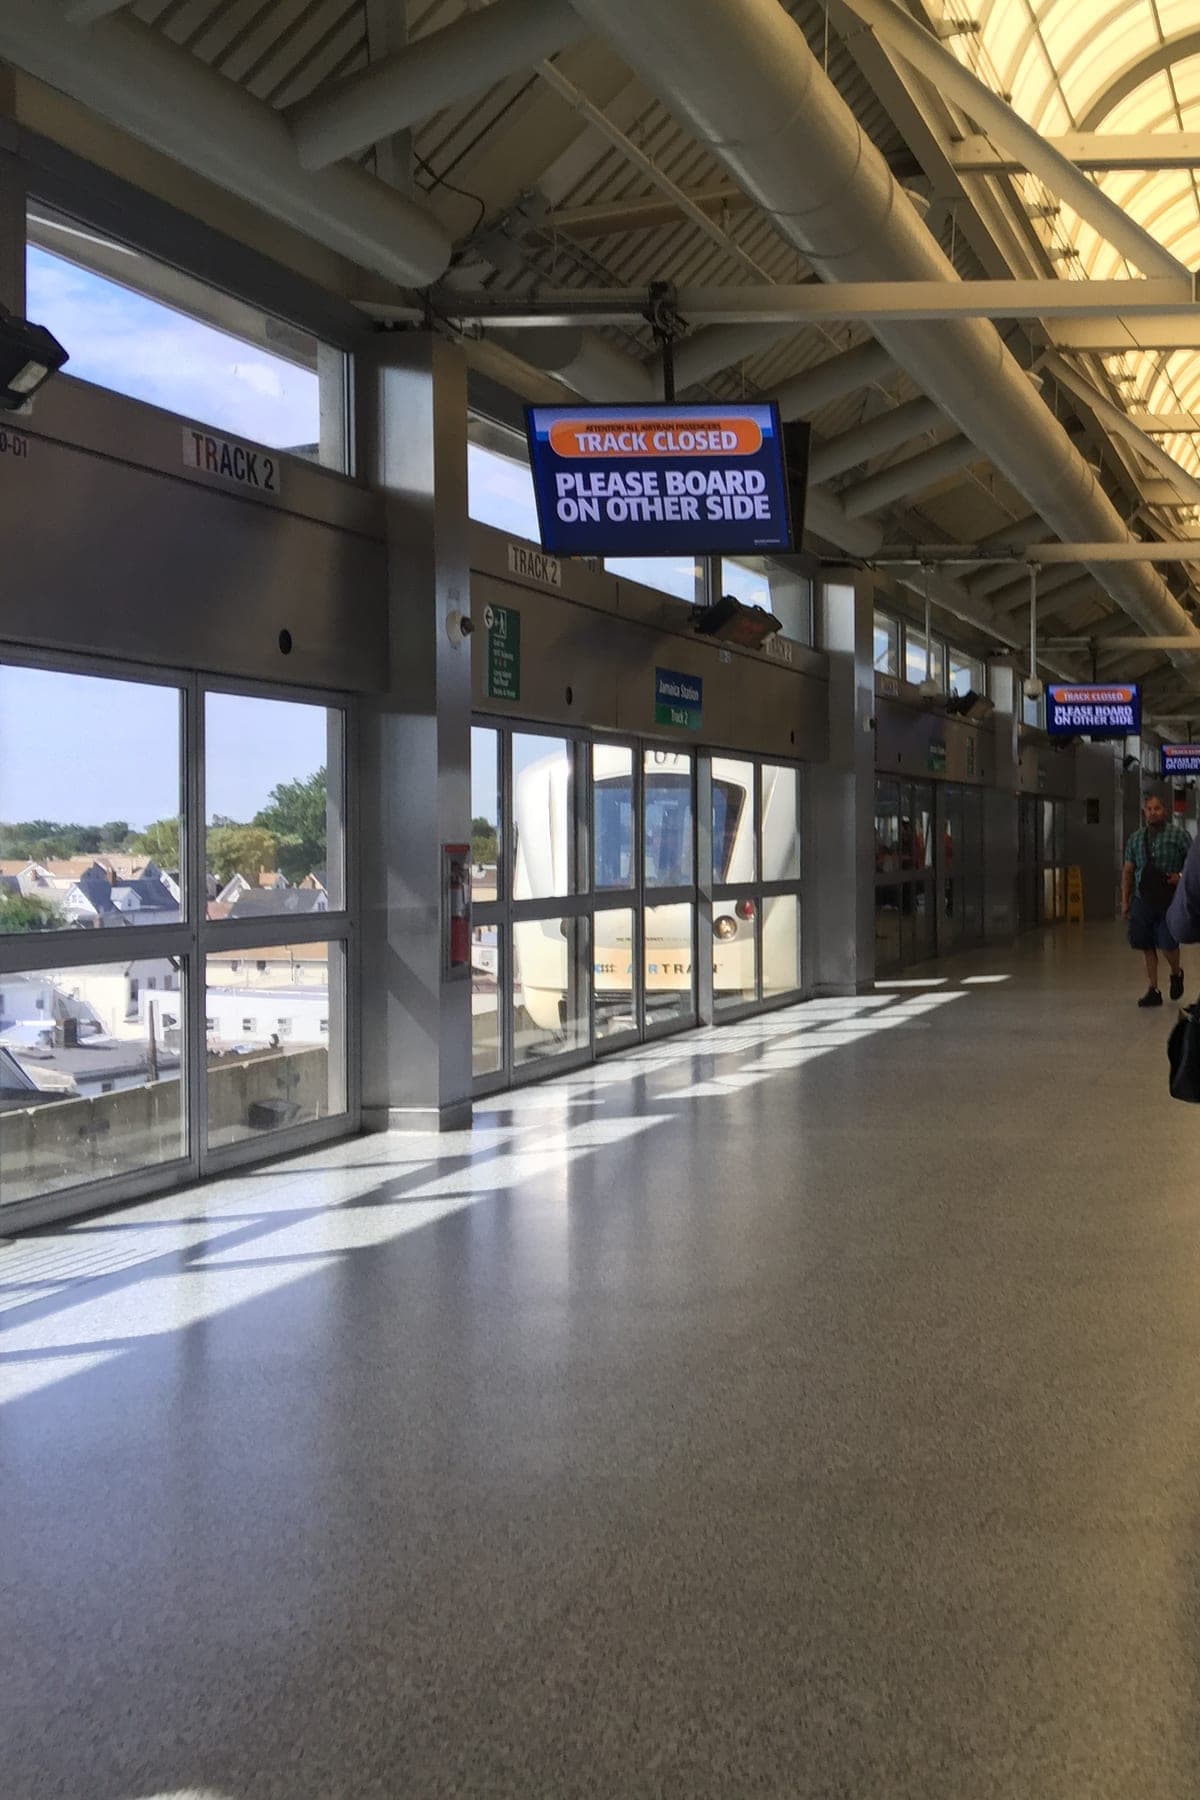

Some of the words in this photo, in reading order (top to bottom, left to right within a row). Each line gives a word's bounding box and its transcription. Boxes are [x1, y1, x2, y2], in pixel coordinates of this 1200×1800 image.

[575, 433, 648, 452] TRACK
[653, 430, 738, 451] CLOSED
[192, 432, 259, 486] TRACK
[263, 459, 275, 490] 2
[555, 471, 660, 498] PLEASE
[665, 470, 766, 496] BOARD
[556, 498, 600, 523] ON
[606, 497, 701, 522] OTHER
[707, 495, 772, 520] SIDE
[512, 546, 549, 581] TRACK
[550, 560, 557, 585] 2
[1064, 692, 1089, 701] TRACK
[1092, 691, 1124, 701] CLOSED
[1054, 705, 1093, 715] PLEASE
[1095, 705, 1133, 715] BOARD
[1054, 714, 1071, 725] ON
[1073, 714, 1107, 725] OTHER
[1109, 714, 1134, 725] SIDE
